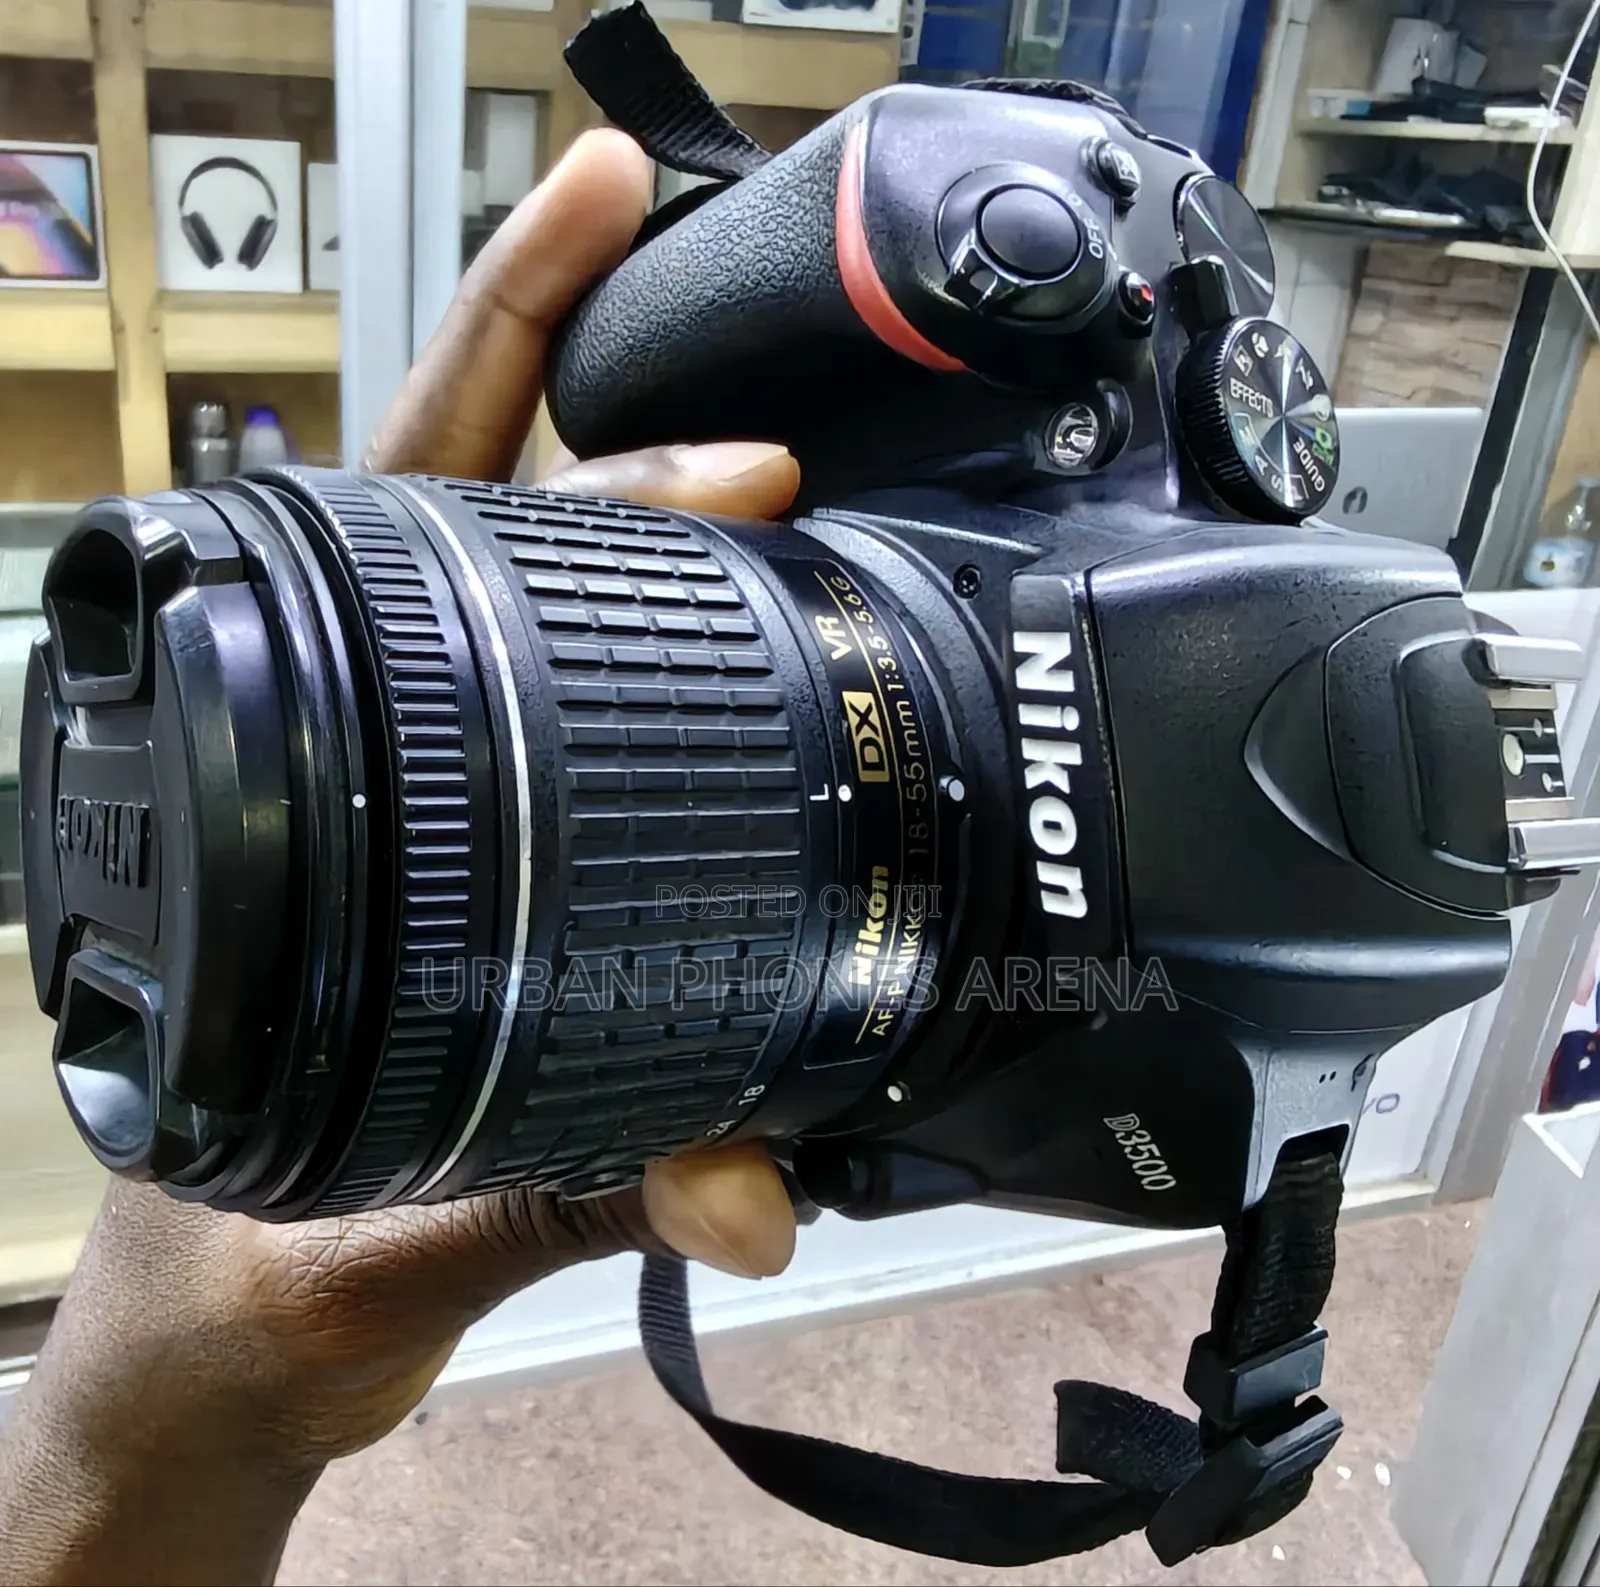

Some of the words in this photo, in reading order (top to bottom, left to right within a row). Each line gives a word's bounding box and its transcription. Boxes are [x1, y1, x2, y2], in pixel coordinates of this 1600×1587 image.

[1083, 217, 1103, 259] OFF
[1230, 378, 1274, 418] EFFECTS
[1255, 454, 1268, 476] A
[1271, 474, 1283, 493] S
[1293, 437, 1325, 493] GUIDE
[814, 615, 852, 661] VR
[830, 575, 905, 692] 1:3.5-5.6G
[846, 698, 887, 774] DX
[809, 783, 830, 801] L
[896, 700, 930, 855] 18-55mm
[1013, 631, 1088, 918] Nikon
[849, 865, 889, 986] Nikon
[872, 982, 906, 1036] AF-P
[738, 1084, 765, 1106] 18
[1103, 1112, 1177, 1190] D3500
